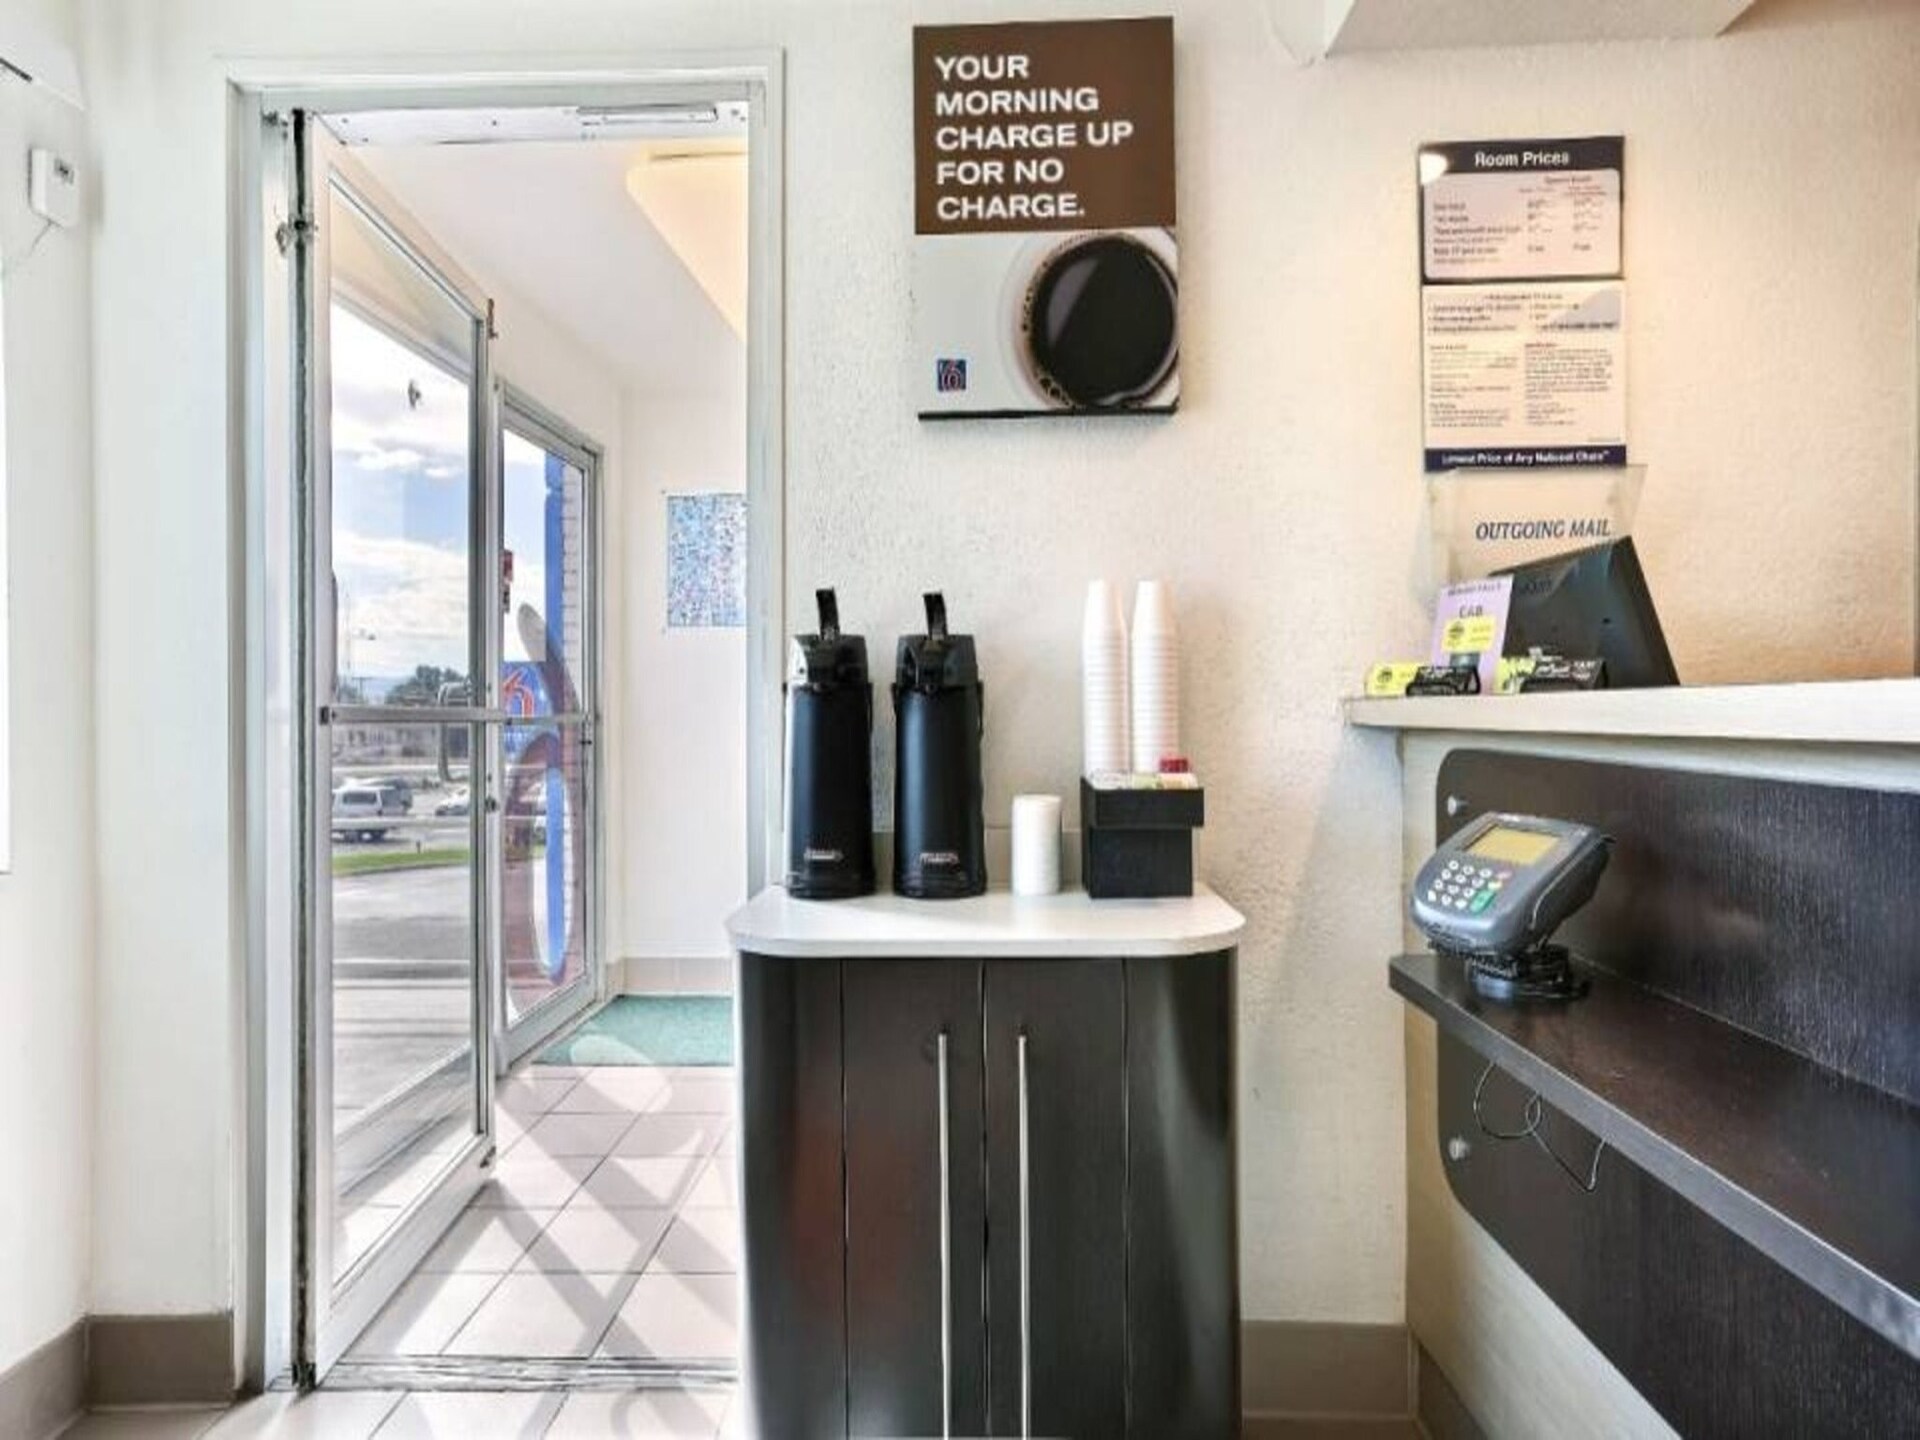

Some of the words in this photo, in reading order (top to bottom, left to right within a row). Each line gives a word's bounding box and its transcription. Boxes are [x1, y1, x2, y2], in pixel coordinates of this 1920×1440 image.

[935, 55, 1030, 81] YOUR
[935, 87, 1099, 116] MORNING
[936, 124, 1077, 151] CHARGE
[1086, 121, 1134, 146] UP
[936, 160, 1004, 186] FOR
[1014, 158, 1064, 184] NO
[1474, 151, 1519, 168] Room
[1522, 151, 1570, 166] Prices
[937, 193, 1085, 221] CHARGE.
[1477, 452, 1501, 464] Price
[1475, 519, 1566, 540] OUTGOING
[1568, 518, 1611, 538] MAIL
